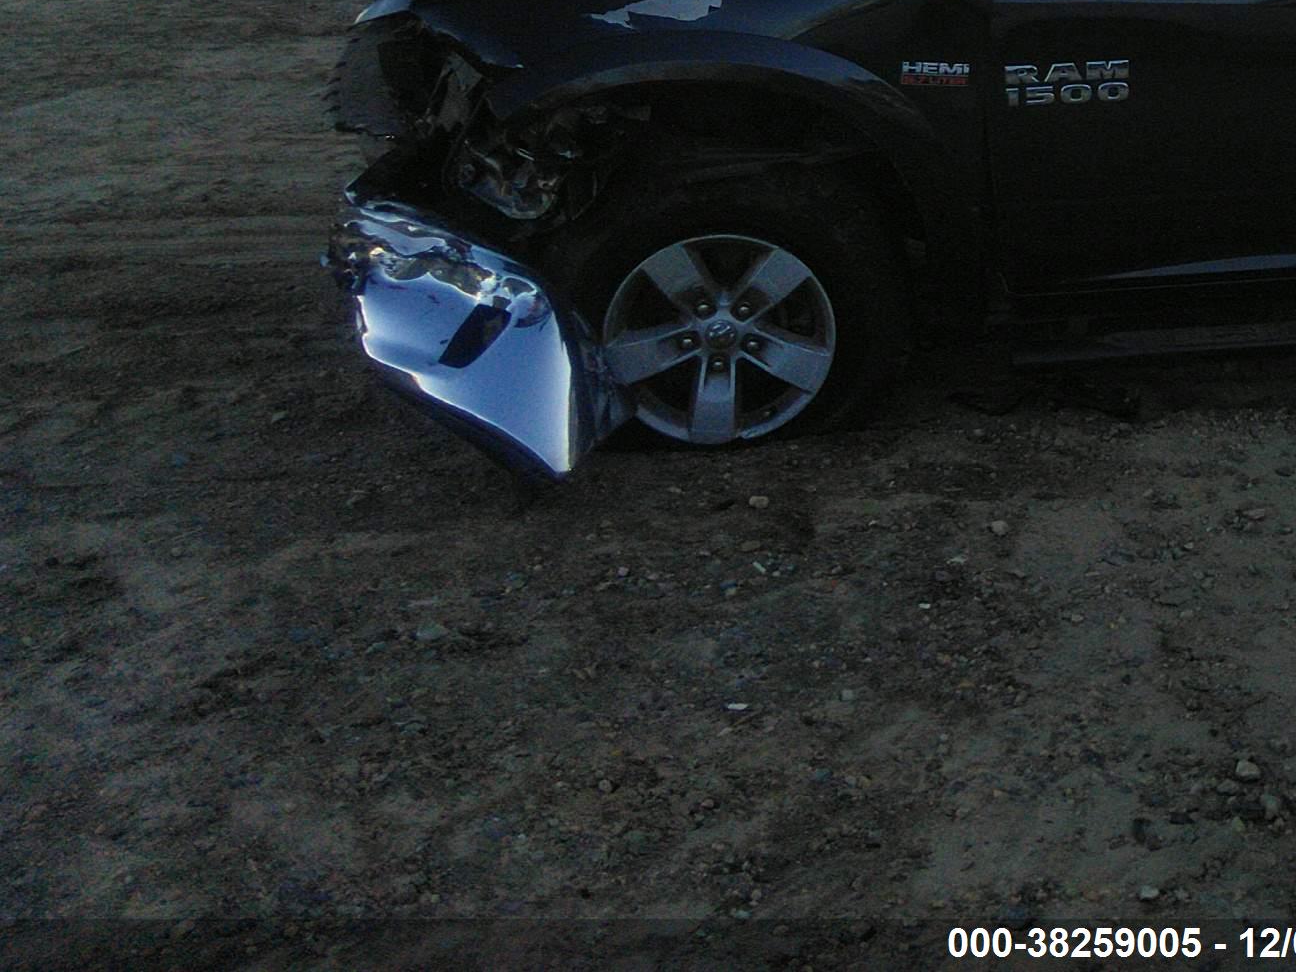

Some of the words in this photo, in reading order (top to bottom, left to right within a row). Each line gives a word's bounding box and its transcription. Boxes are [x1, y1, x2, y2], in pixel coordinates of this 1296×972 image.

[902, 61, 970, 75] HEMI
[1004, 59, 1130, 83] RAM
[1005, 82, 1131, 107] 1500
